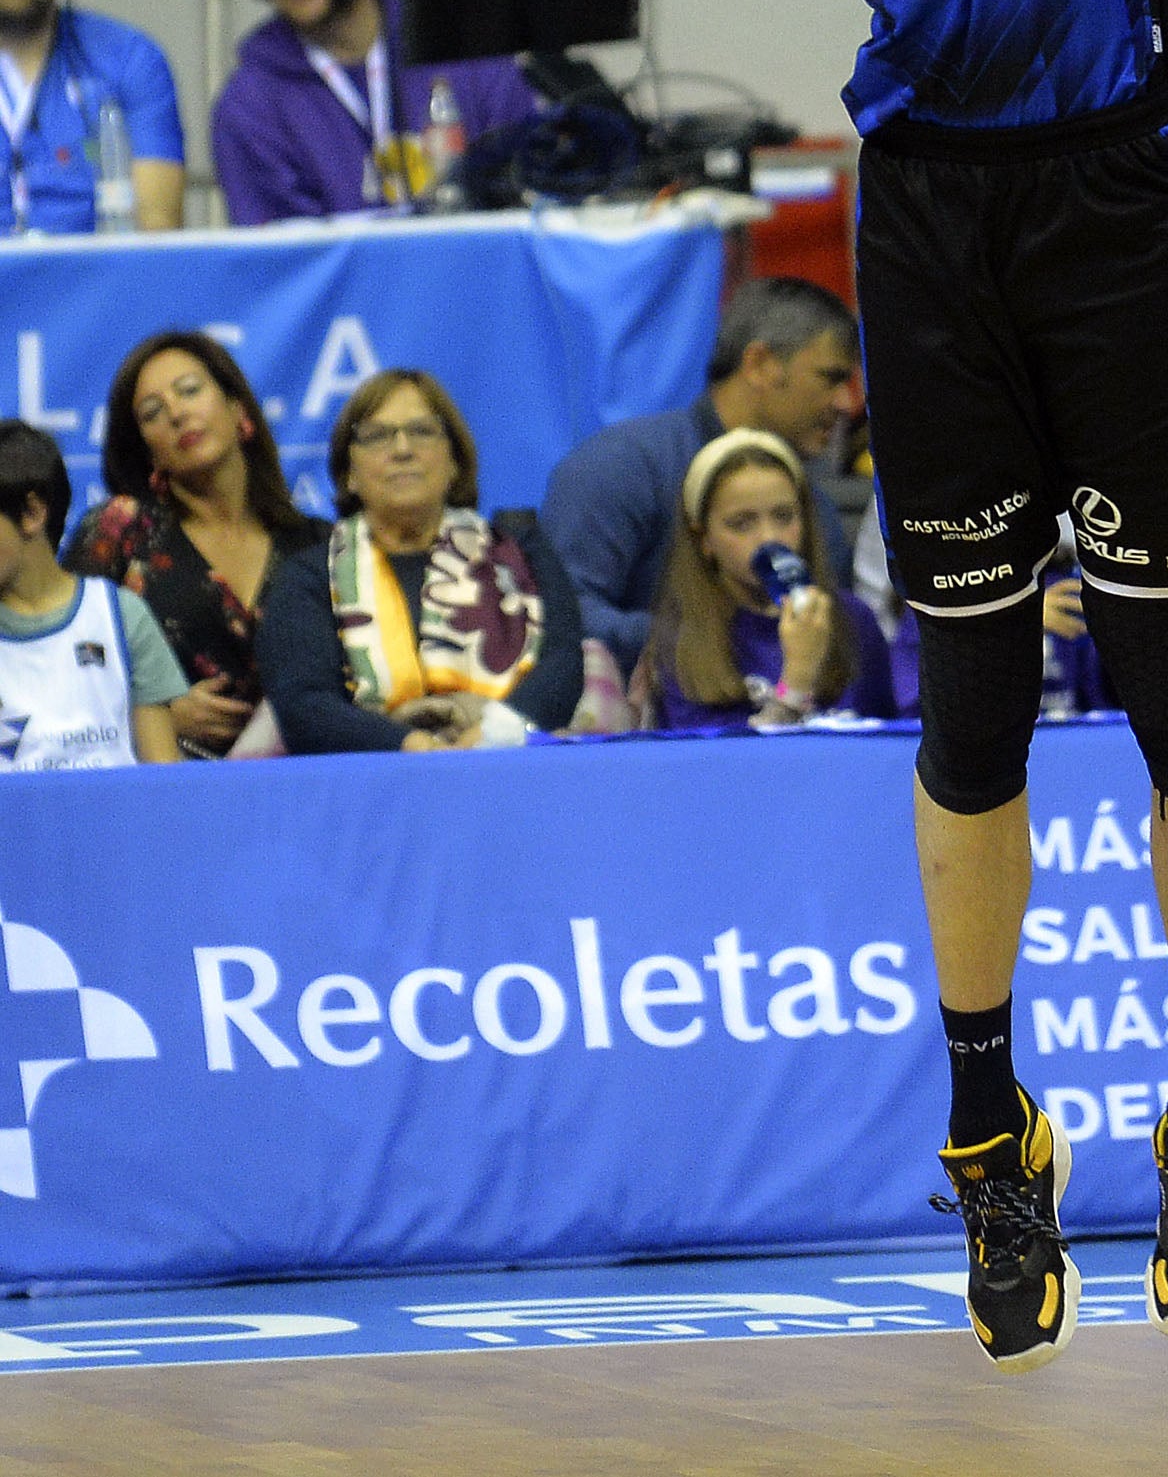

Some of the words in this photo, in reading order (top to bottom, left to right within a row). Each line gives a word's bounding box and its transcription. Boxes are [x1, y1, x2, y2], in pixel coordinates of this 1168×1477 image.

[903, 517, 978, 534] CASTILLA
[982, 509, 994, 526] Y
[933, 563, 1014, 590] GIVOVA
[193, 918, 917, 1071] Recoletas
